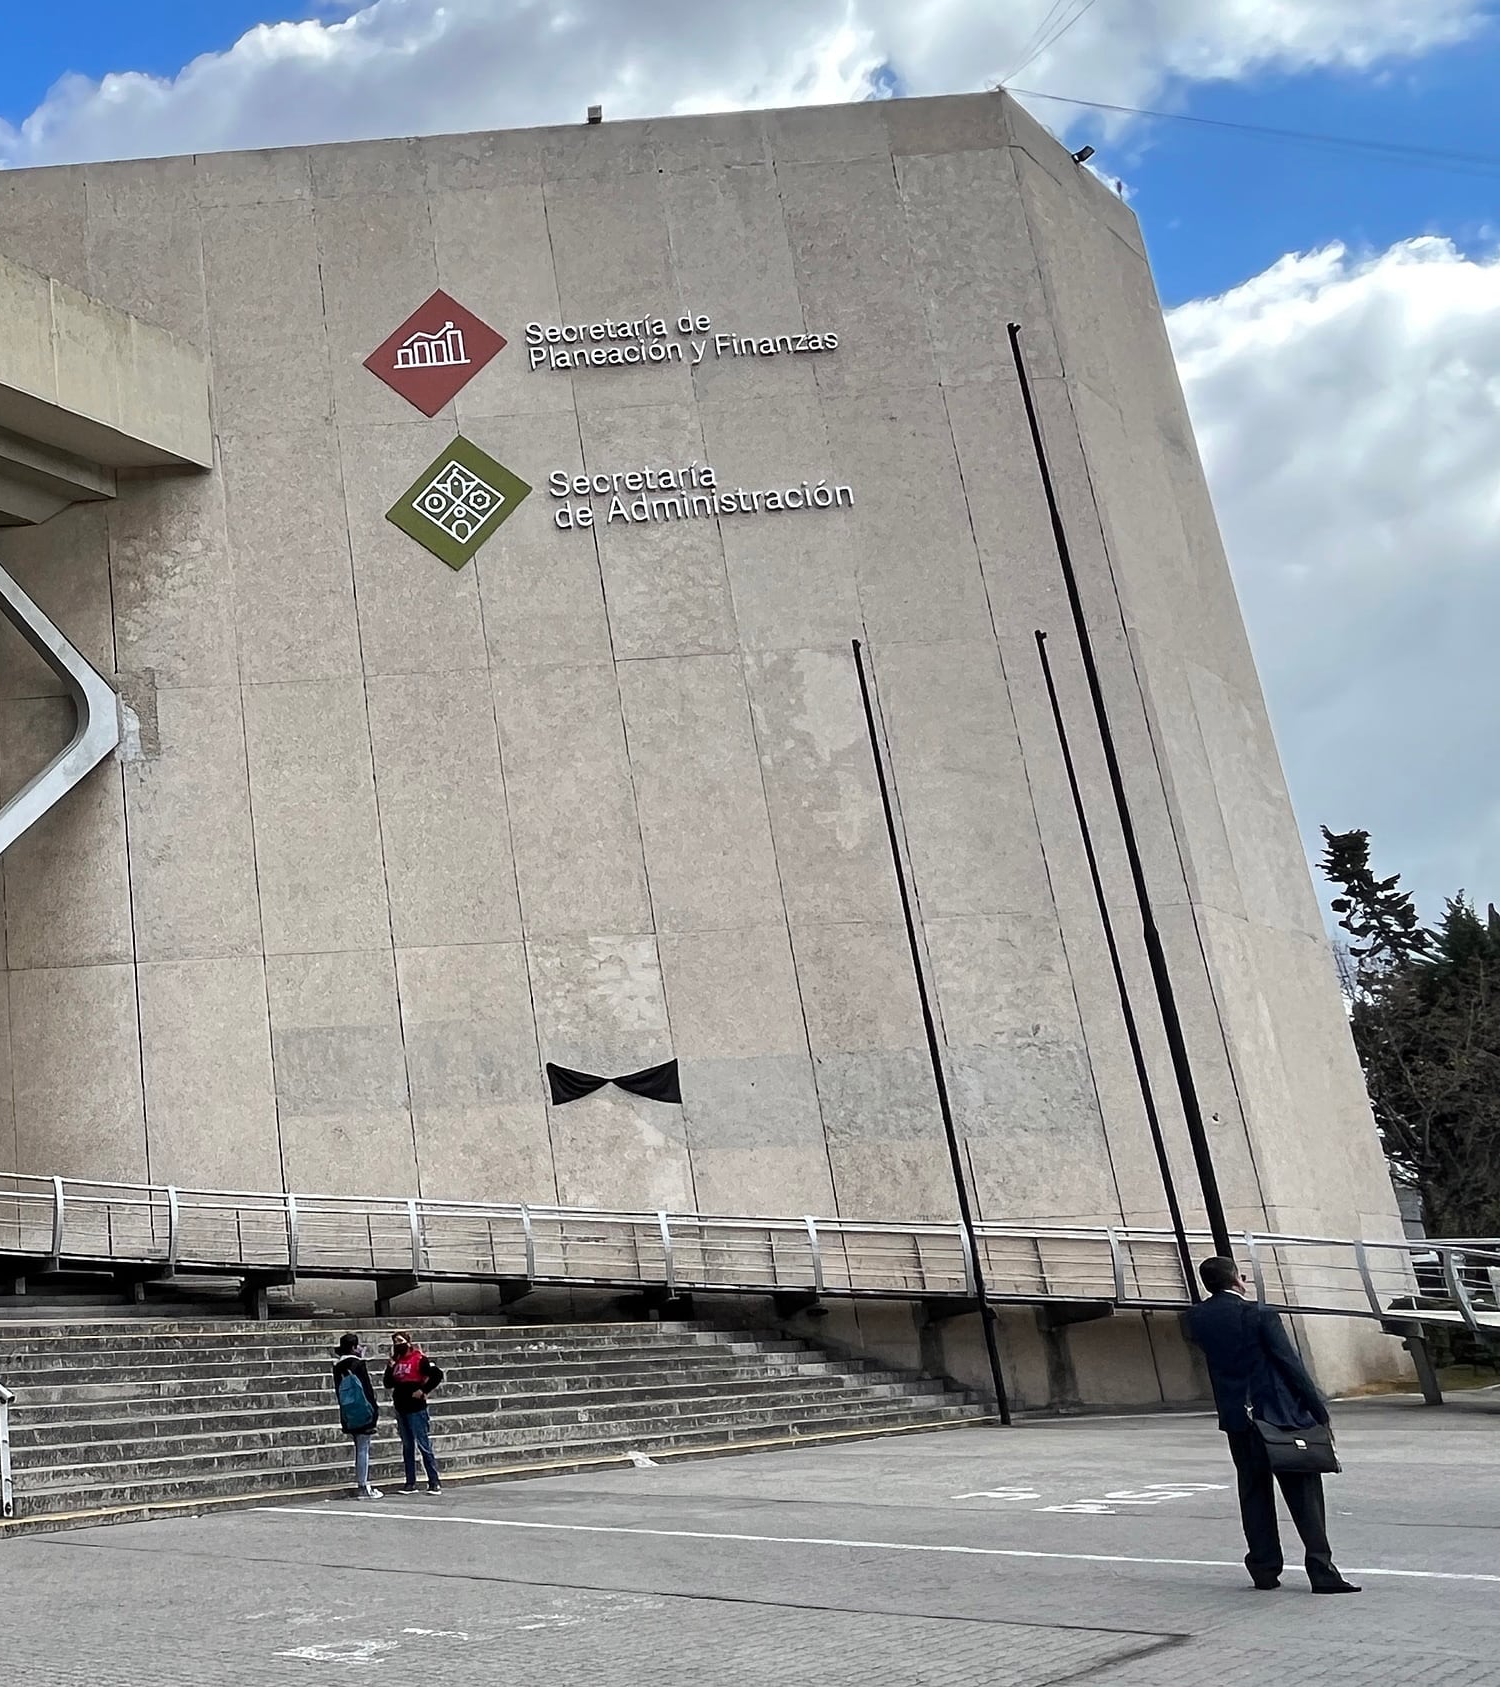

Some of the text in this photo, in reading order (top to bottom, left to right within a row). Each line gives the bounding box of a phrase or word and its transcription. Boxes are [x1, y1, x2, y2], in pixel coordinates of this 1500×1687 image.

[525, 309, 711, 345] Secretaría de
[529, 332, 839, 370] Planeación y Finanzas
[549, 460, 717, 498] Secretaría
[555, 479, 855, 529] de Administración
